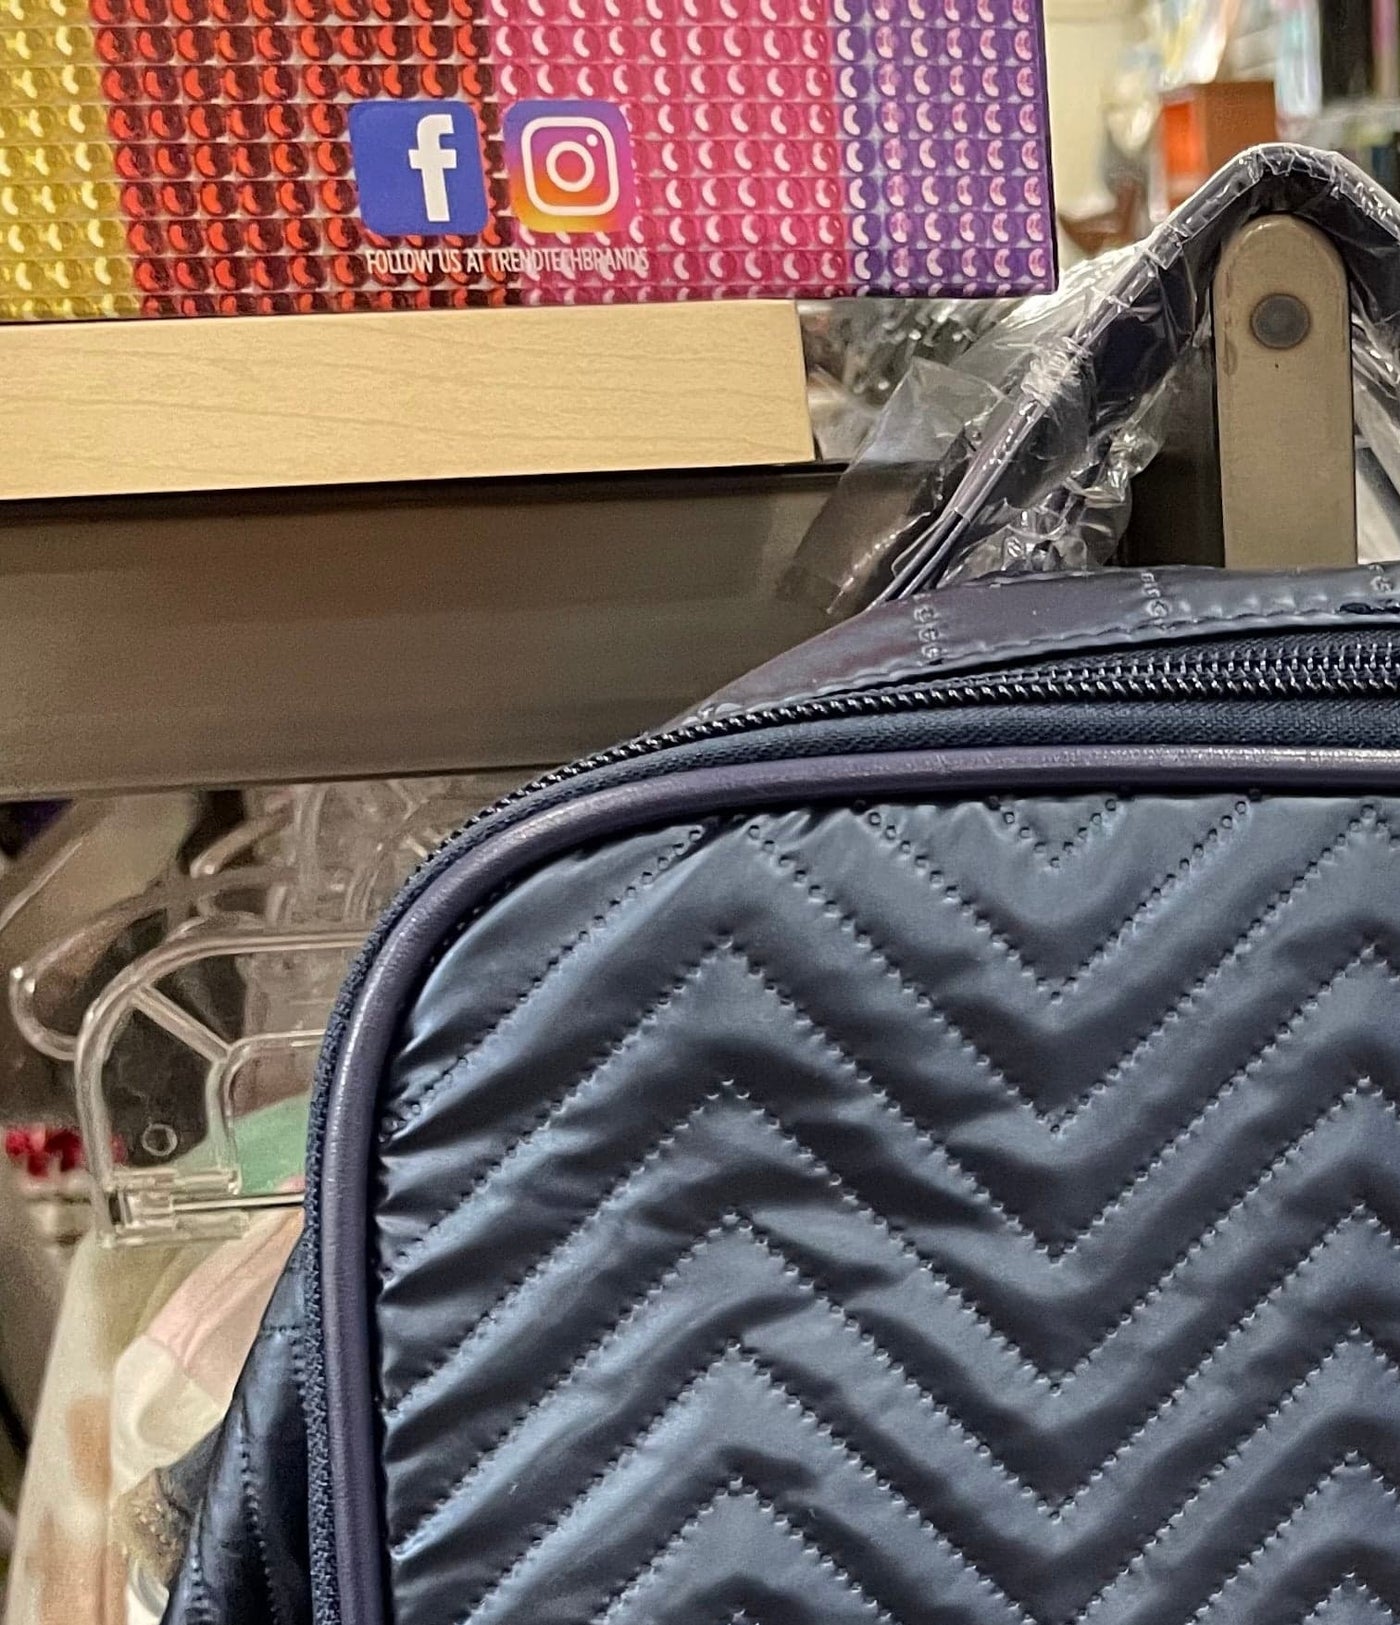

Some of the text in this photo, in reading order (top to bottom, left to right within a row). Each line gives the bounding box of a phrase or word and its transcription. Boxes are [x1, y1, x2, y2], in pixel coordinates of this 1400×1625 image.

[408, 114, 457, 222] f
[365, 249, 433, 274] FOLLOW
[438, 249, 462, 273] US
[463, 248, 485, 273] AT
